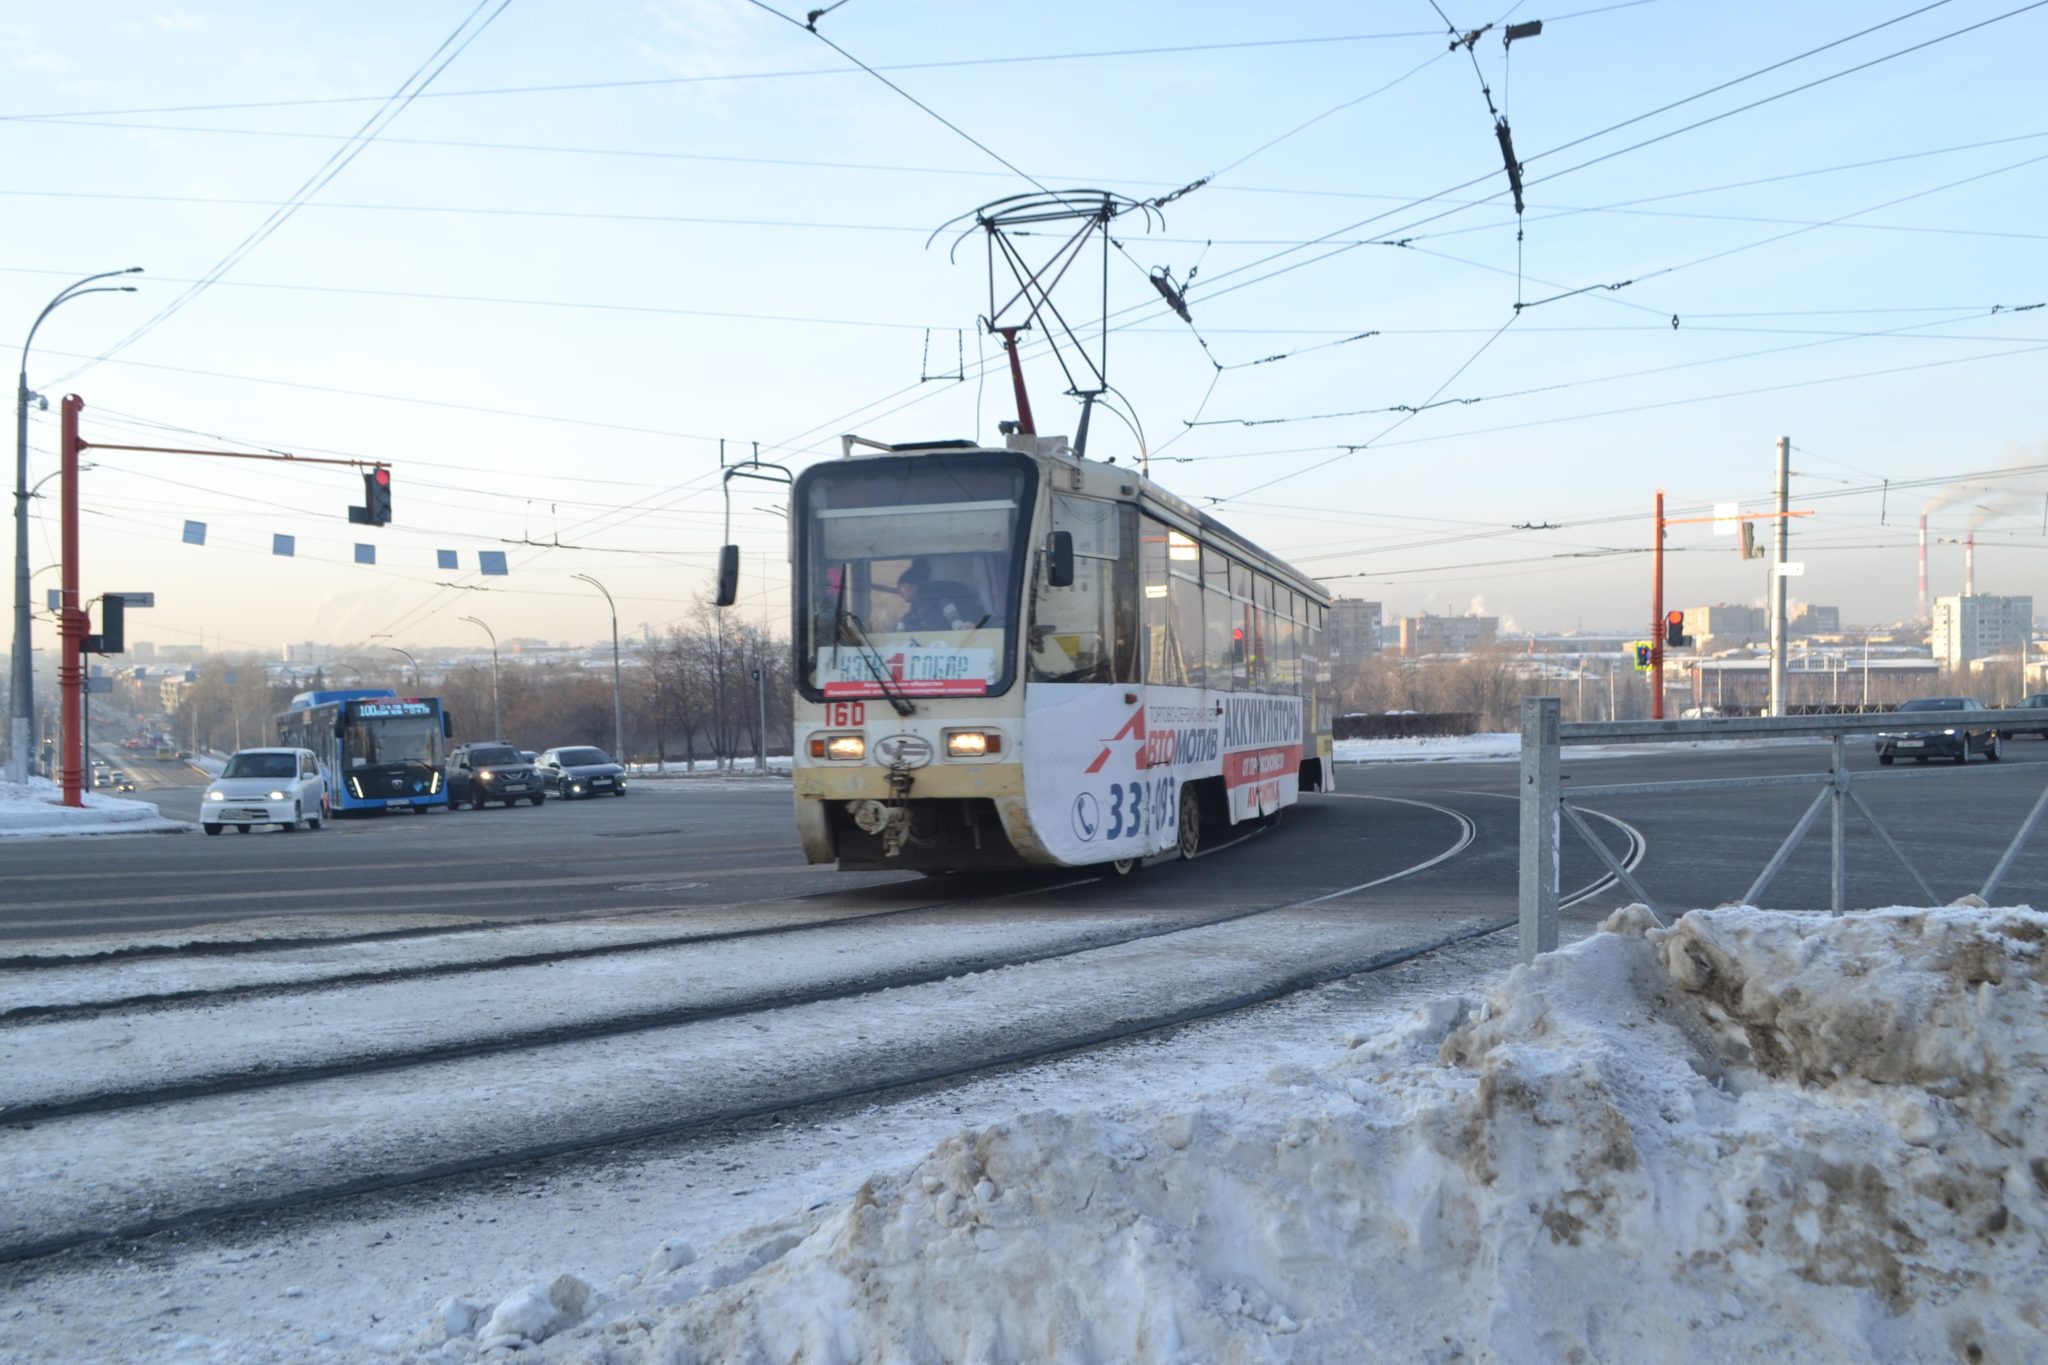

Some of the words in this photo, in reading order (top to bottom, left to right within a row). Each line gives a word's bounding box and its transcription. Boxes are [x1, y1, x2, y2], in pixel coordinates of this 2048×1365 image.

[885, 653, 905, 682] 1
[359, 704, 376, 717] 100
[825, 702, 865, 726] 160
[1223, 697, 1302, 748] АККУМУЛЯТОРЫ
